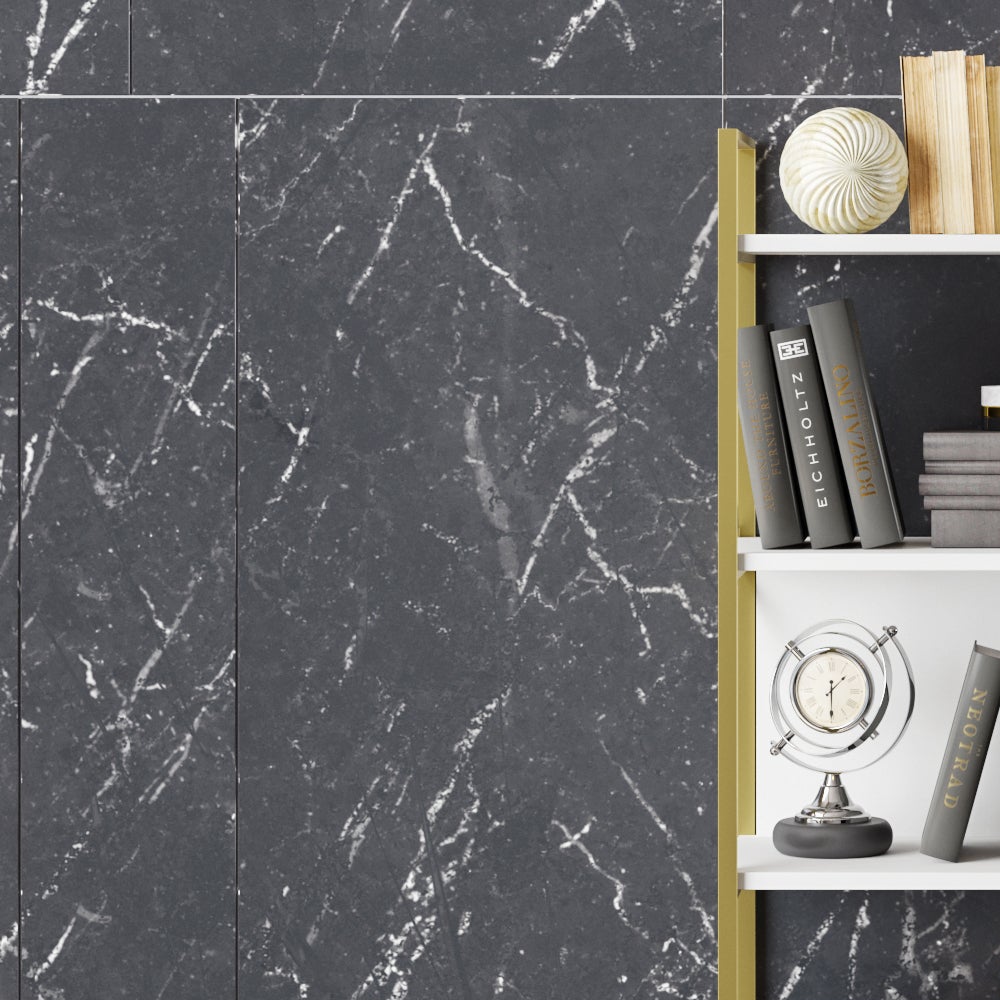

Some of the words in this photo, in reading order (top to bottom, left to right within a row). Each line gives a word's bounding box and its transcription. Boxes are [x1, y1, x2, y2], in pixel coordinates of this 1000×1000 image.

[758, 392, 782, 476] FURNITURE
[792, 372, 828, 508] EICHHOLTZ
[832, 364, 878, 498] BORZALINO
[943, 687, 989, 810] NEOTRAD
